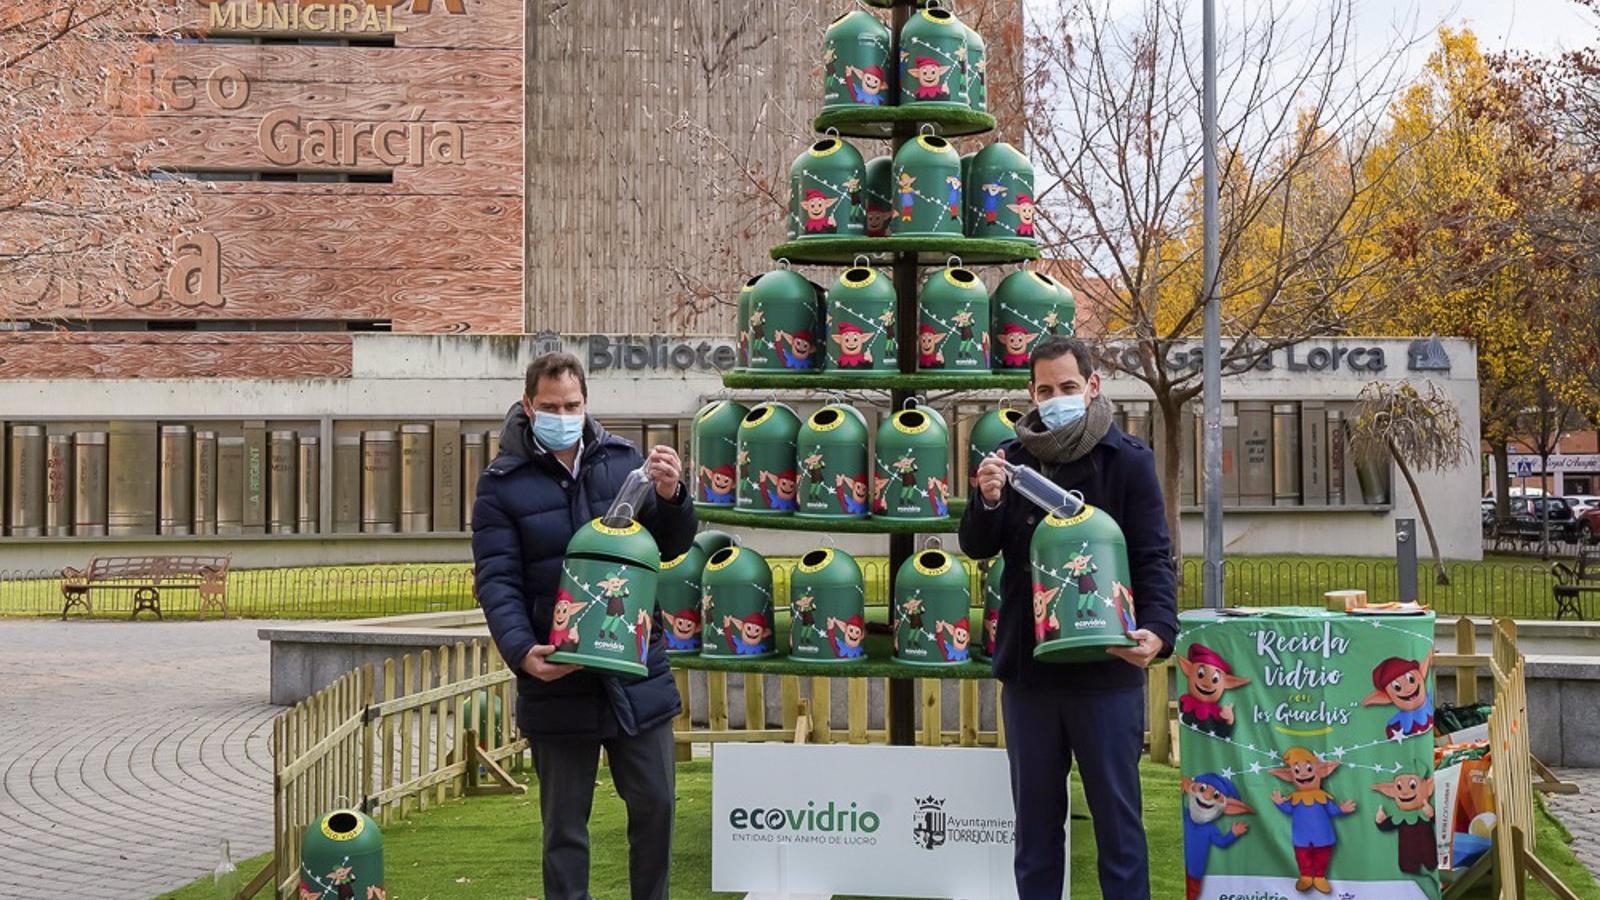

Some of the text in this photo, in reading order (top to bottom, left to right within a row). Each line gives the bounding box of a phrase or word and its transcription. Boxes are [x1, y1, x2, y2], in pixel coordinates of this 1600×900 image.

[208, 2, 408, 33] MUNICIPAL
[256, 106, 465, 167] García
[588, 334, 736, 371] Bibliote
[1287, 337, 1387, 372] Lorca
[729, 800, 880, 833] ecovidrio
[947, 816, 1014, 828] Ayuntamien
[732, 833, 774, 843] ENTIDAD
[776, 834, 792, 843] SIN
[828, 835, 841, 845] DE
[842, 835, 878, 846] LUCRO
[996, 830, 1009, 844] DE
